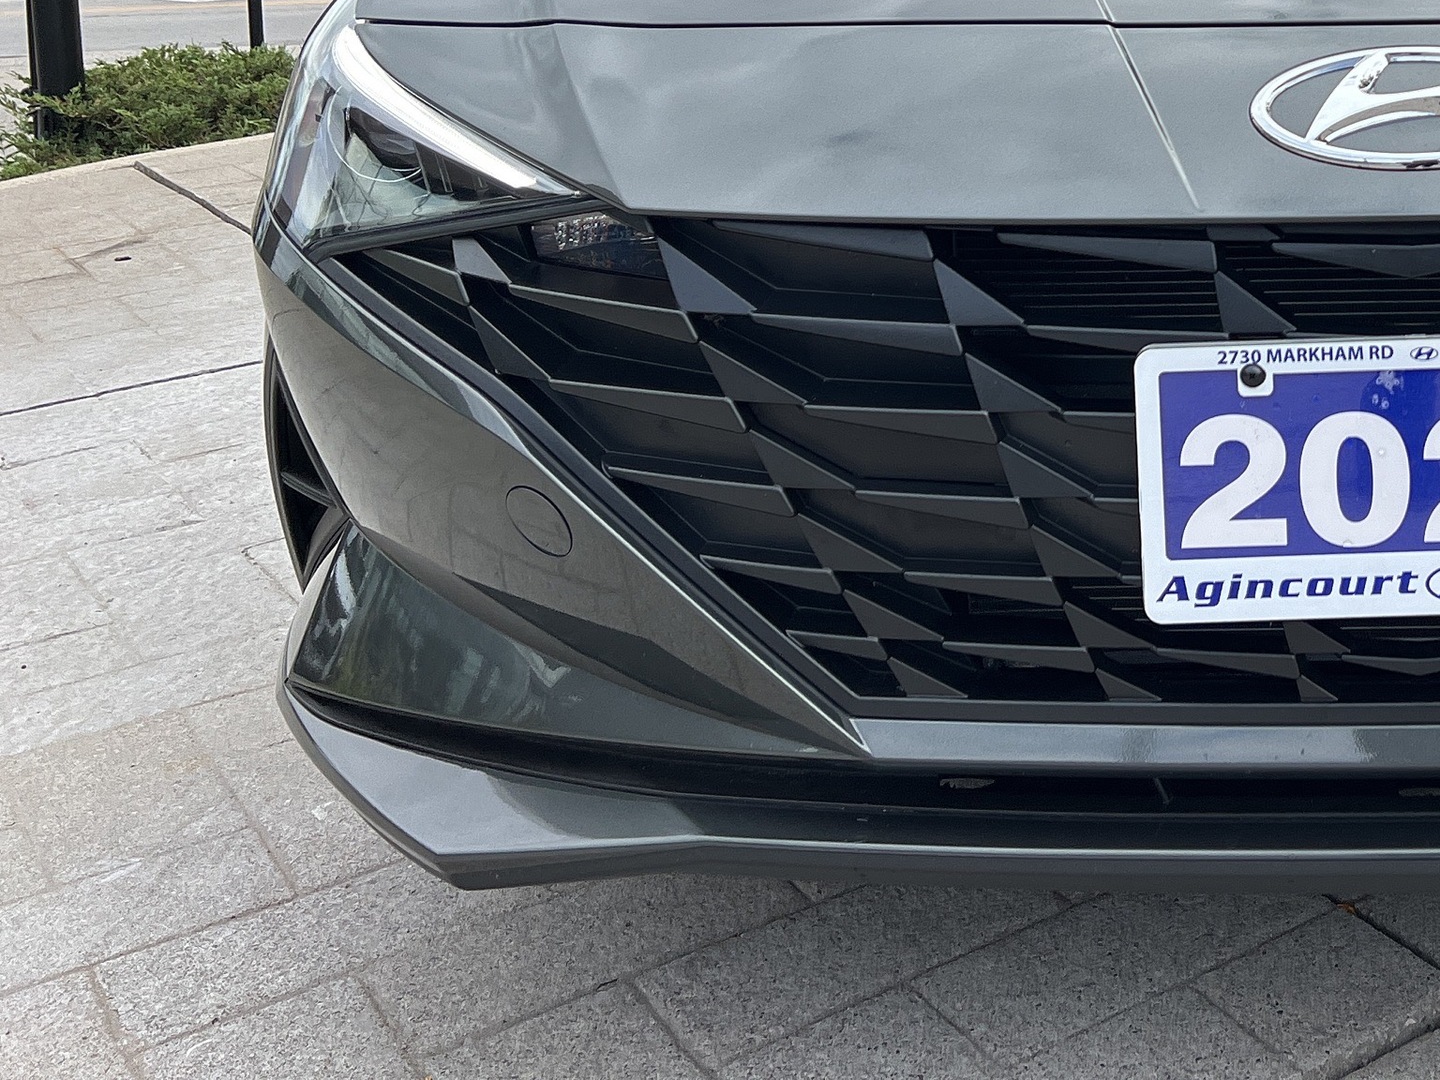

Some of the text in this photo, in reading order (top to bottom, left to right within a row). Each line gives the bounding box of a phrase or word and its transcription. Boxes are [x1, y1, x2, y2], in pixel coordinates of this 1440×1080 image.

[1217, 349, 1262, 365] 2730
[1267, 345, 1364, 363] MARKHAM
[1369, 345, 1394, 360] RD
[1156, 570, 1419, 608] Agincourt
